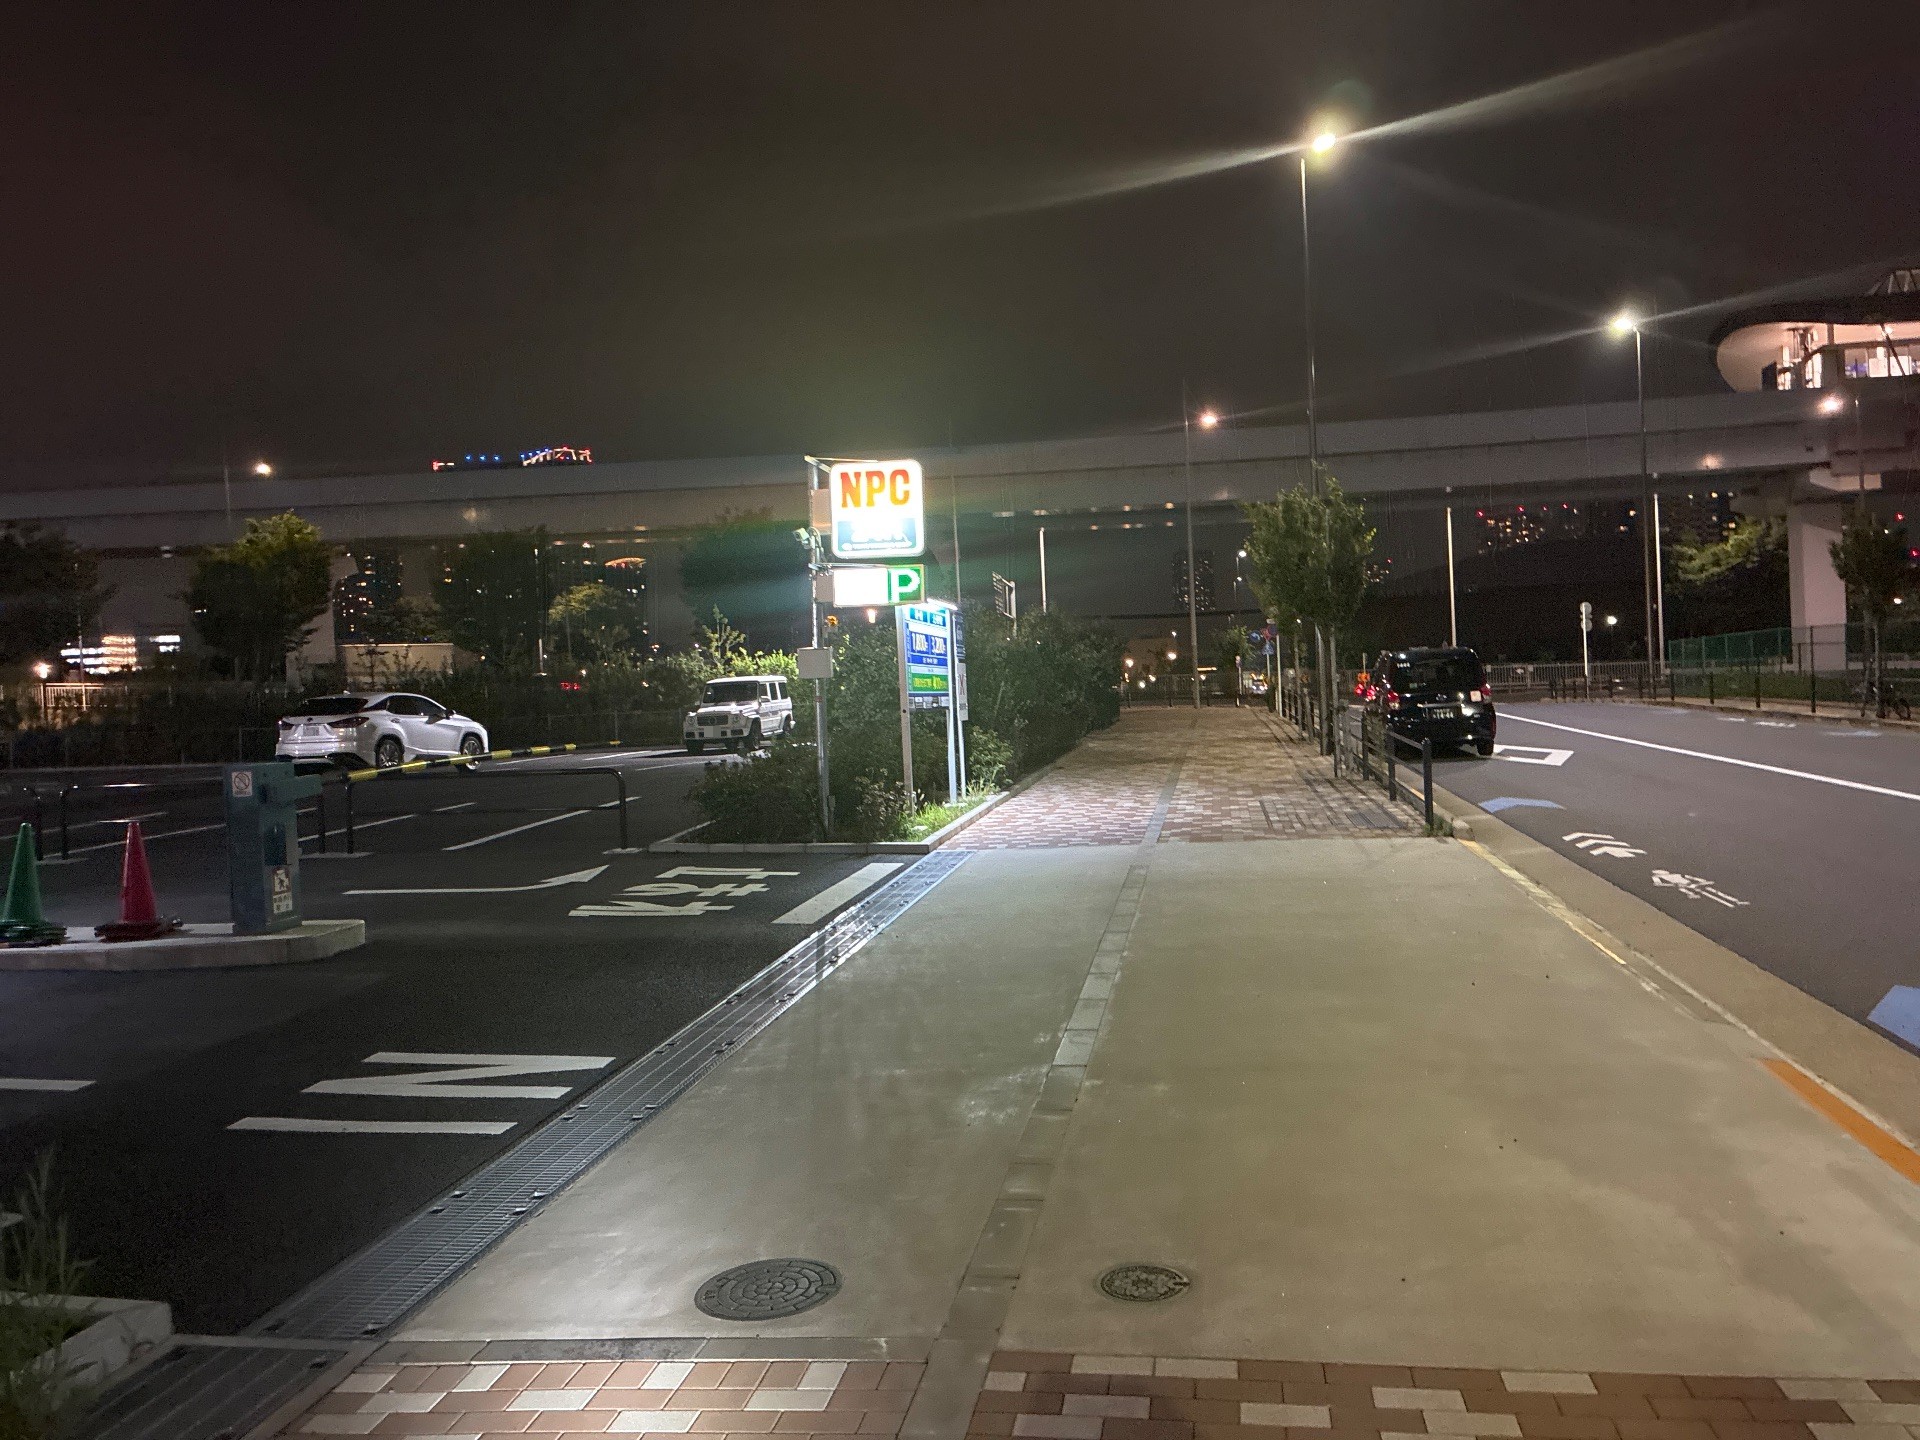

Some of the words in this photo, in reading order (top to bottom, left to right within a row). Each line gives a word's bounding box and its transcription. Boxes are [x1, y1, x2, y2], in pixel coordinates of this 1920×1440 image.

[840, 469, 910, 508] NPC
[891, 569, 920, 602] P
[568, 865, 801, 917] とまれ
[226, 1051, 617, 1135] IN
